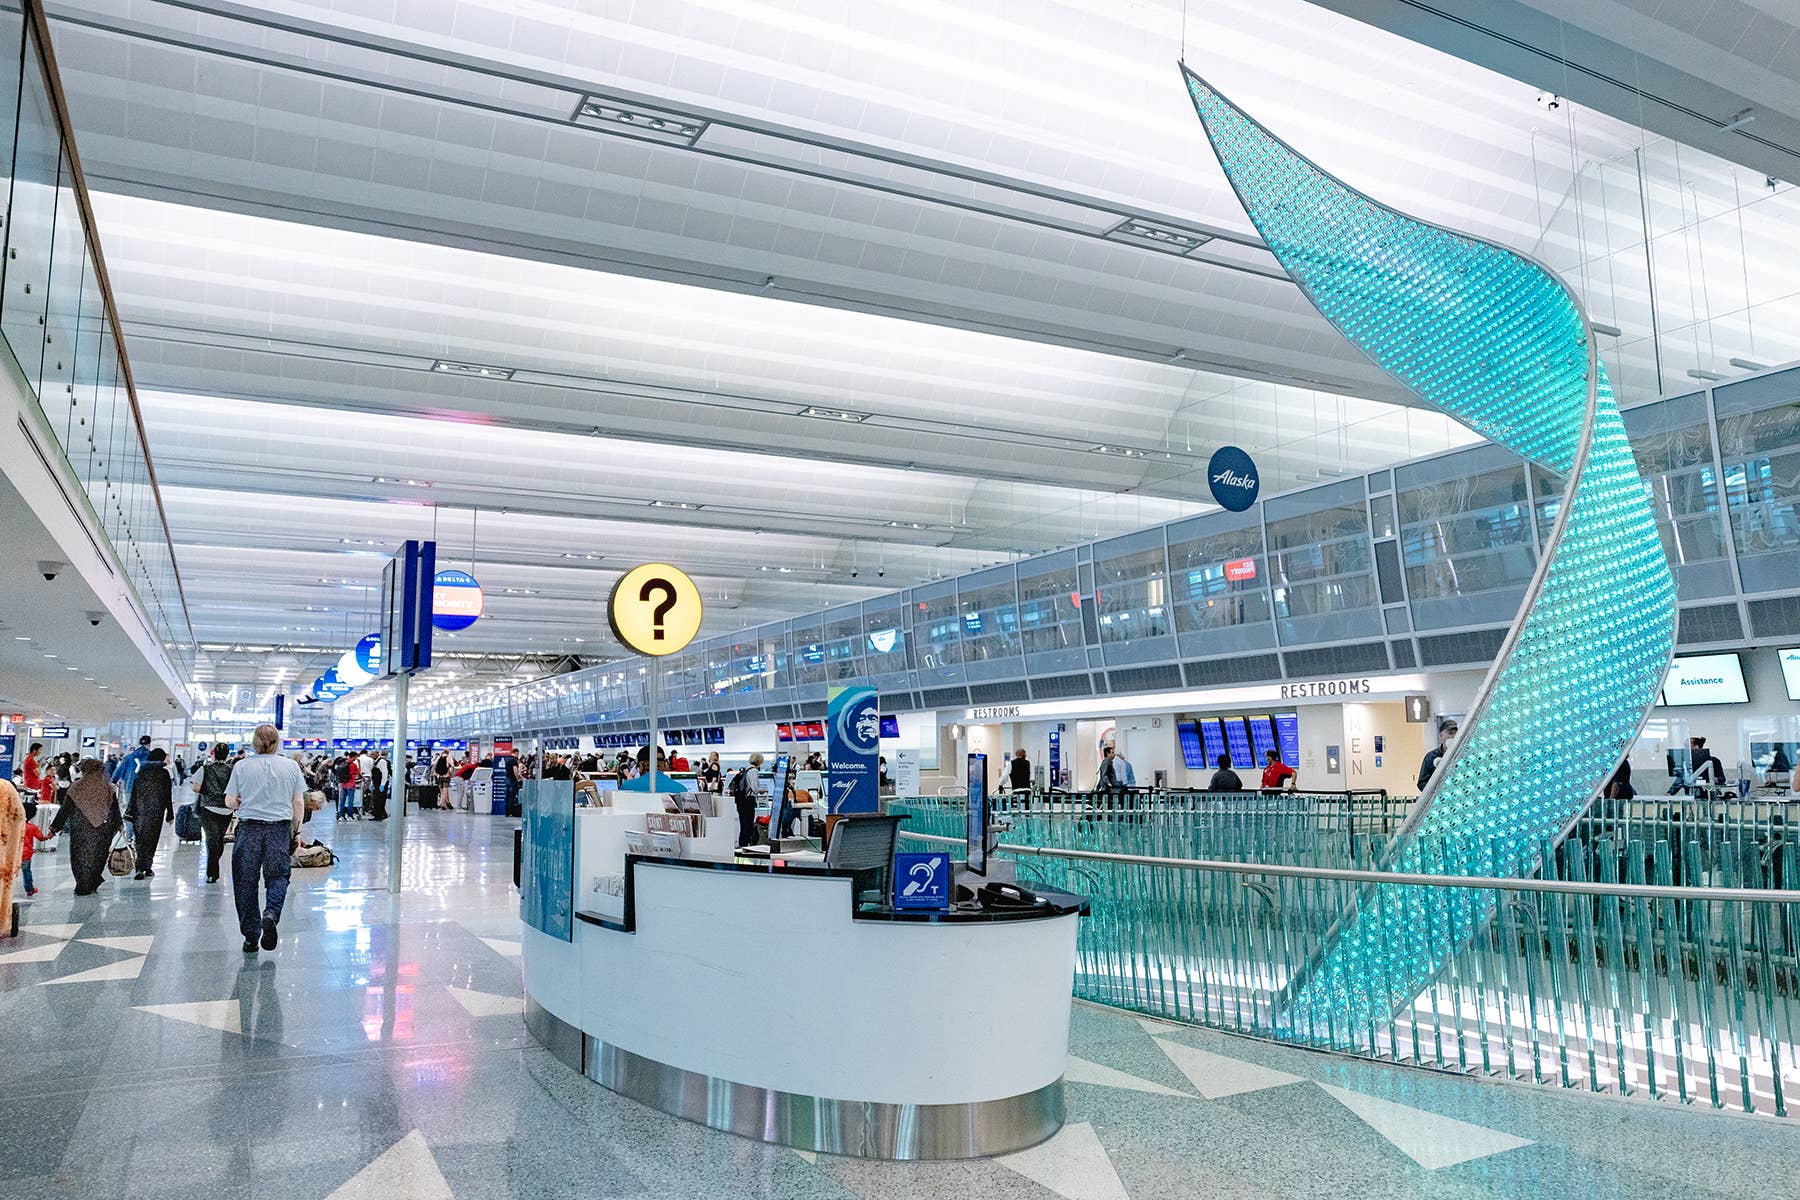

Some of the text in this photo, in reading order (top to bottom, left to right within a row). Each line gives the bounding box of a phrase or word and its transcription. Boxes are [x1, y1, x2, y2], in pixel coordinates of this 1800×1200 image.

[1213, 469, 1256, 490] Alaska
[1680, 678, 1724, 686] Assistance
[1281, 679, 1370, 699] RESTROOMS
[974, 706, 1020, 719] RESTROOMS
[931, 886, 939, 894] T
